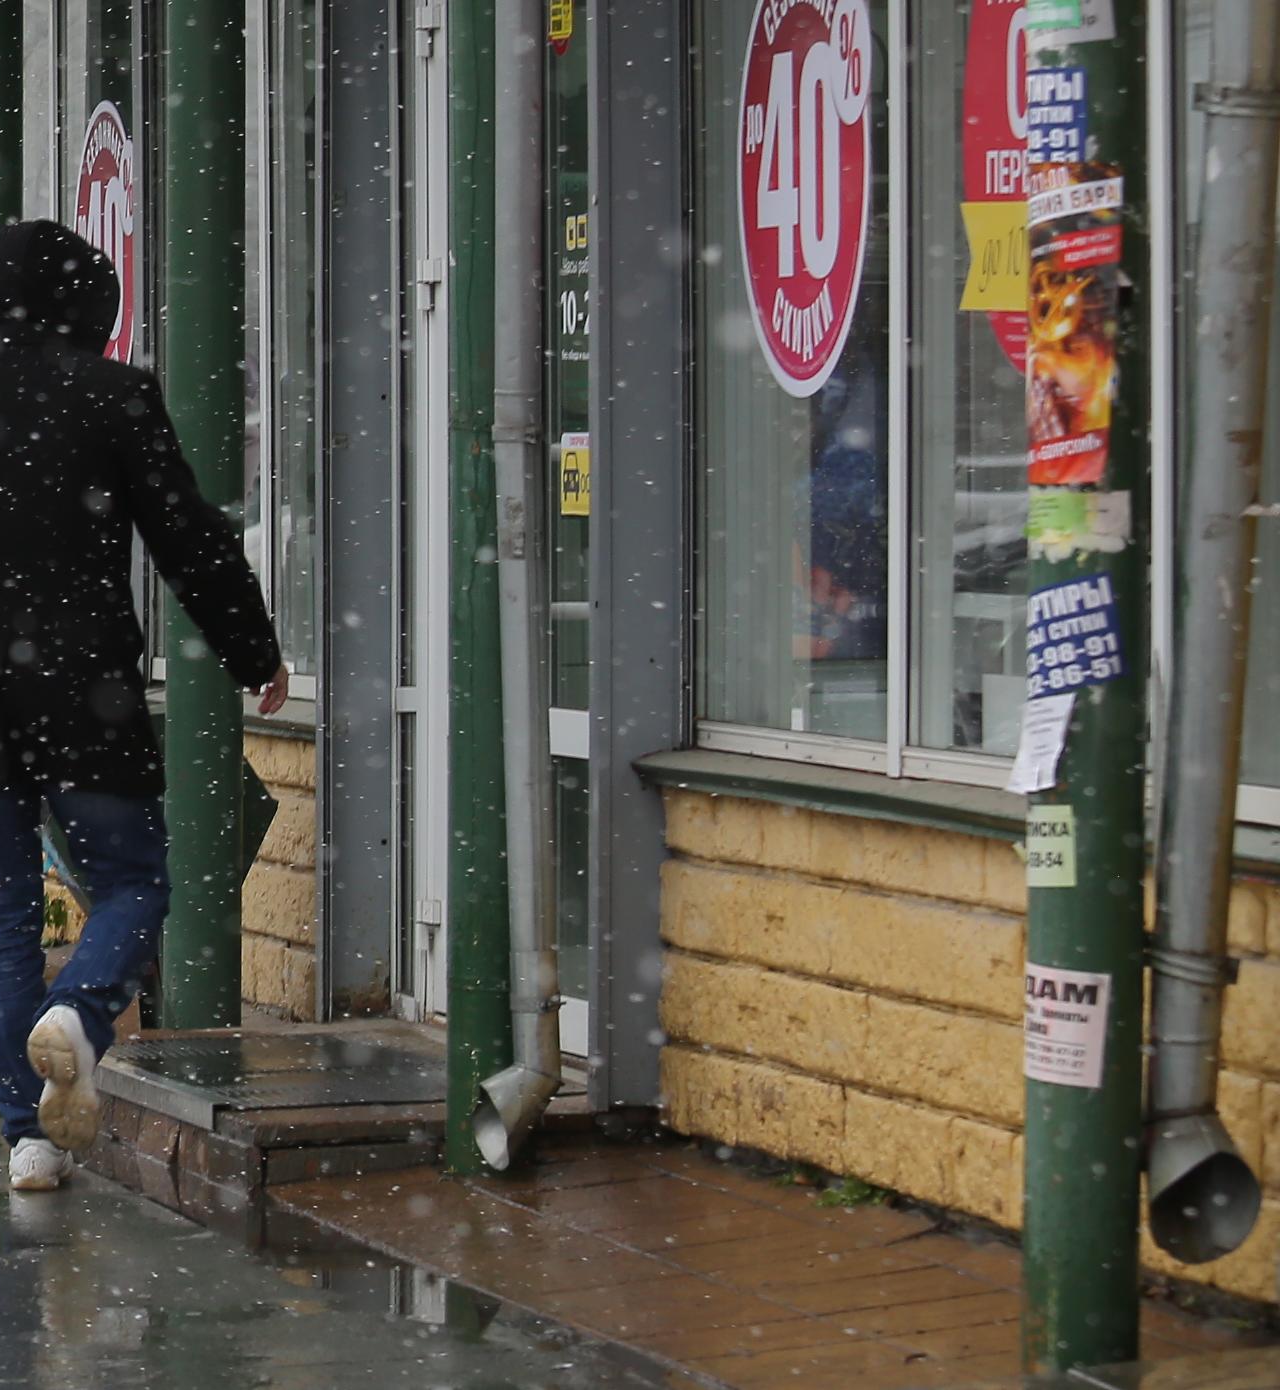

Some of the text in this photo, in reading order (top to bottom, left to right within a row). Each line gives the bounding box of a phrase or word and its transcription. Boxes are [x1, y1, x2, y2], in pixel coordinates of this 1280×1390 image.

[746, 103, 764, 154] ДО
[772, 279, 834, 363] СКИДКИ
[1047, 611, 1108, 641] СУТКИ
